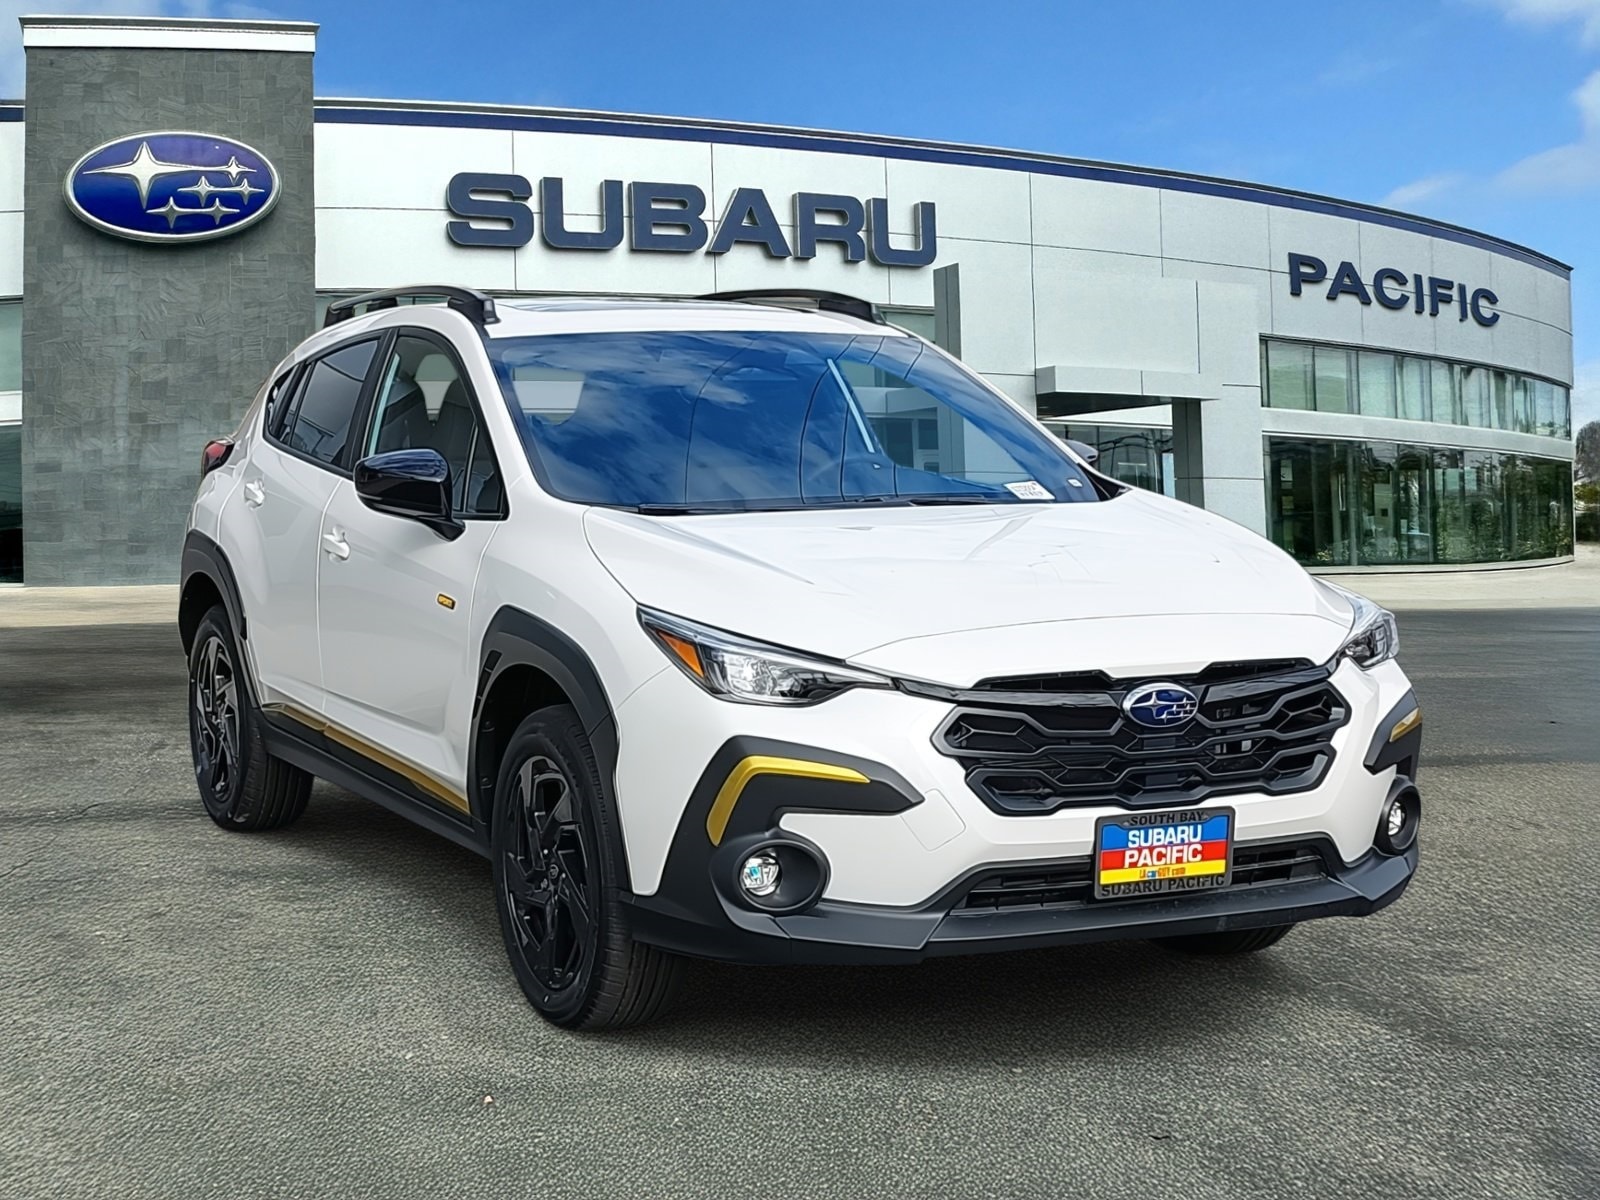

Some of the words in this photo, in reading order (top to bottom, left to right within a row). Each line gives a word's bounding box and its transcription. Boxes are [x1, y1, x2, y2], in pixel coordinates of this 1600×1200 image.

[446, 172, 937, 268] SUBARU
[1288, 251, 1500, 327] PACIFIC
[1130, 814, 1174, 826] SOUTH
[1180, 811, 1205, 823] BAY
[1127, 824, 1202, 848] SUBARU
[1123, 843, 1203, 869] PACIFIC
[1101, 879, 1162, 897] SUBARU
[1168, 875, 1225, 891] PACIFIC
